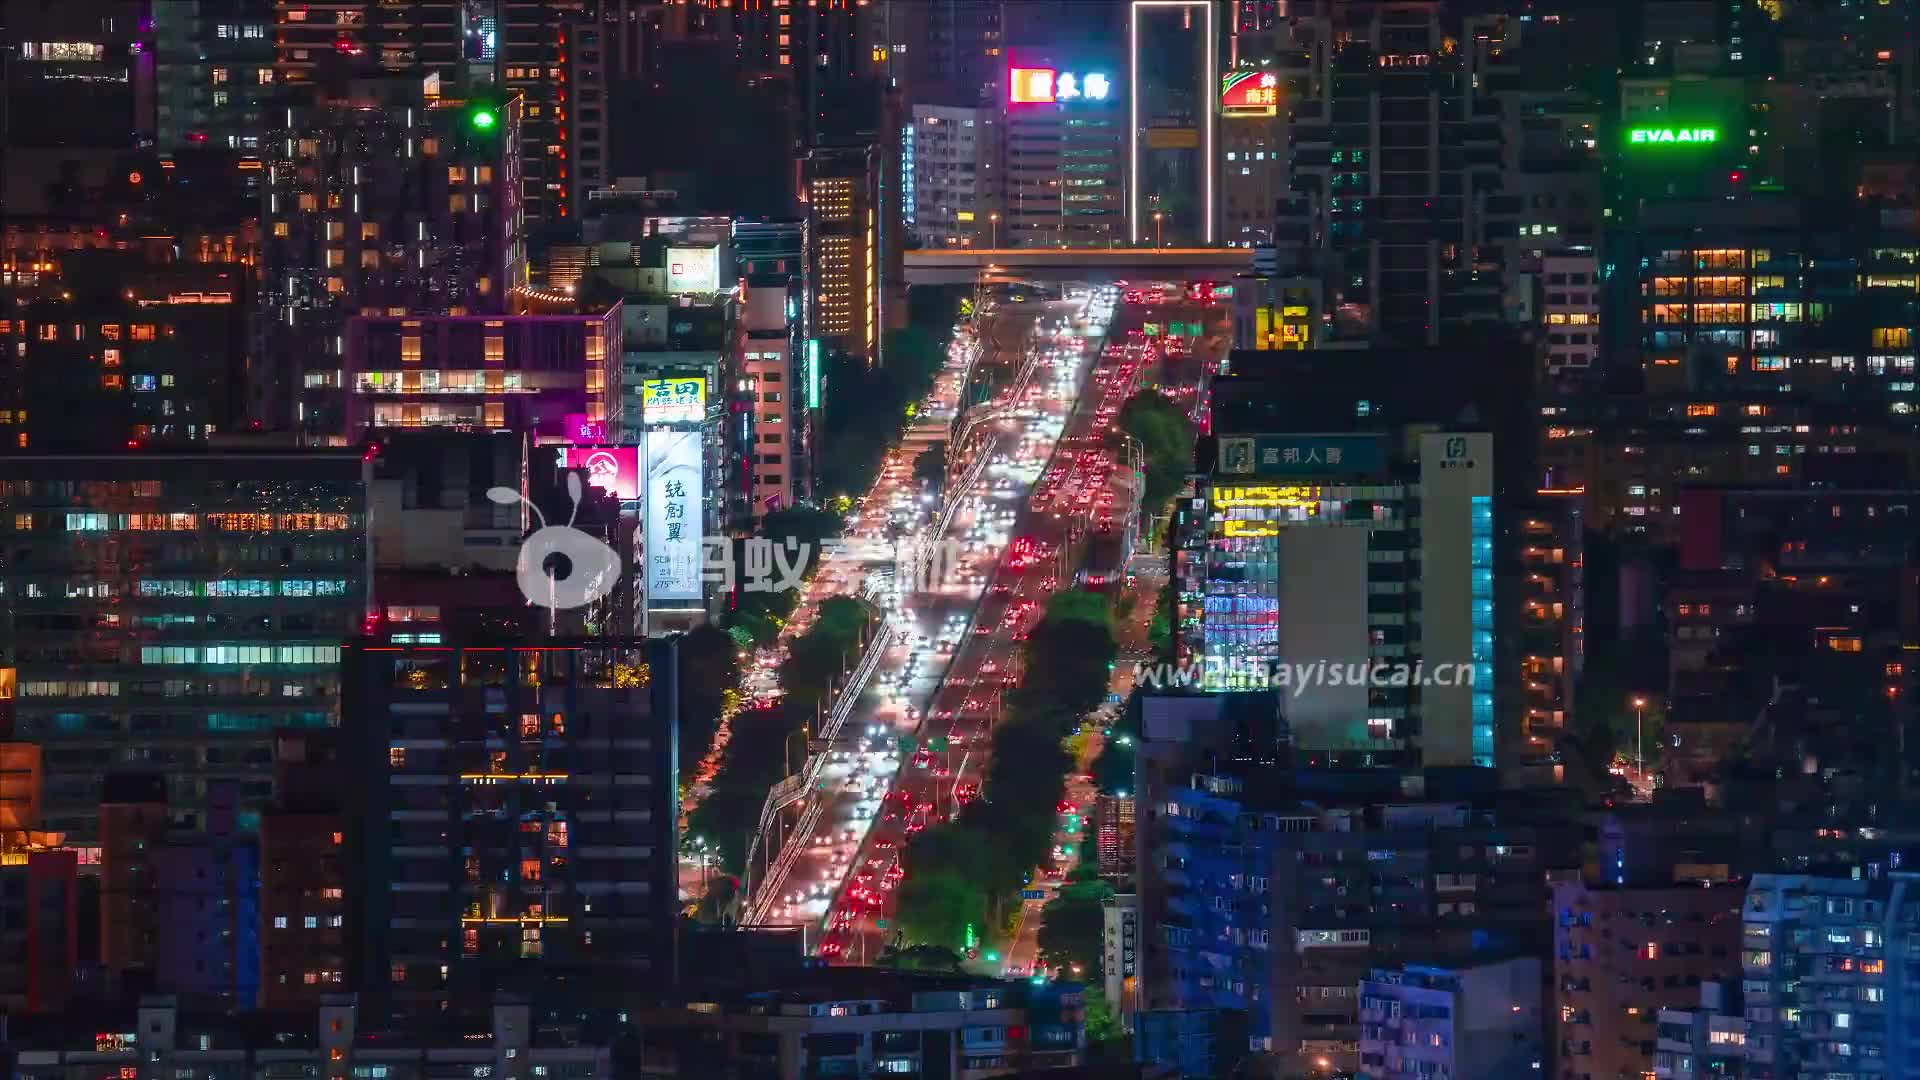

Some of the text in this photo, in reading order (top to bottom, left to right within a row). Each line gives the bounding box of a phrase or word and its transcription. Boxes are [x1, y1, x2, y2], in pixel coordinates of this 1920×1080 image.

[647, 380, 700, 397] 吉田
[1262, 448, 1343, 465] 富邦人壽
[664, 479, 687, 543] 統創翼
